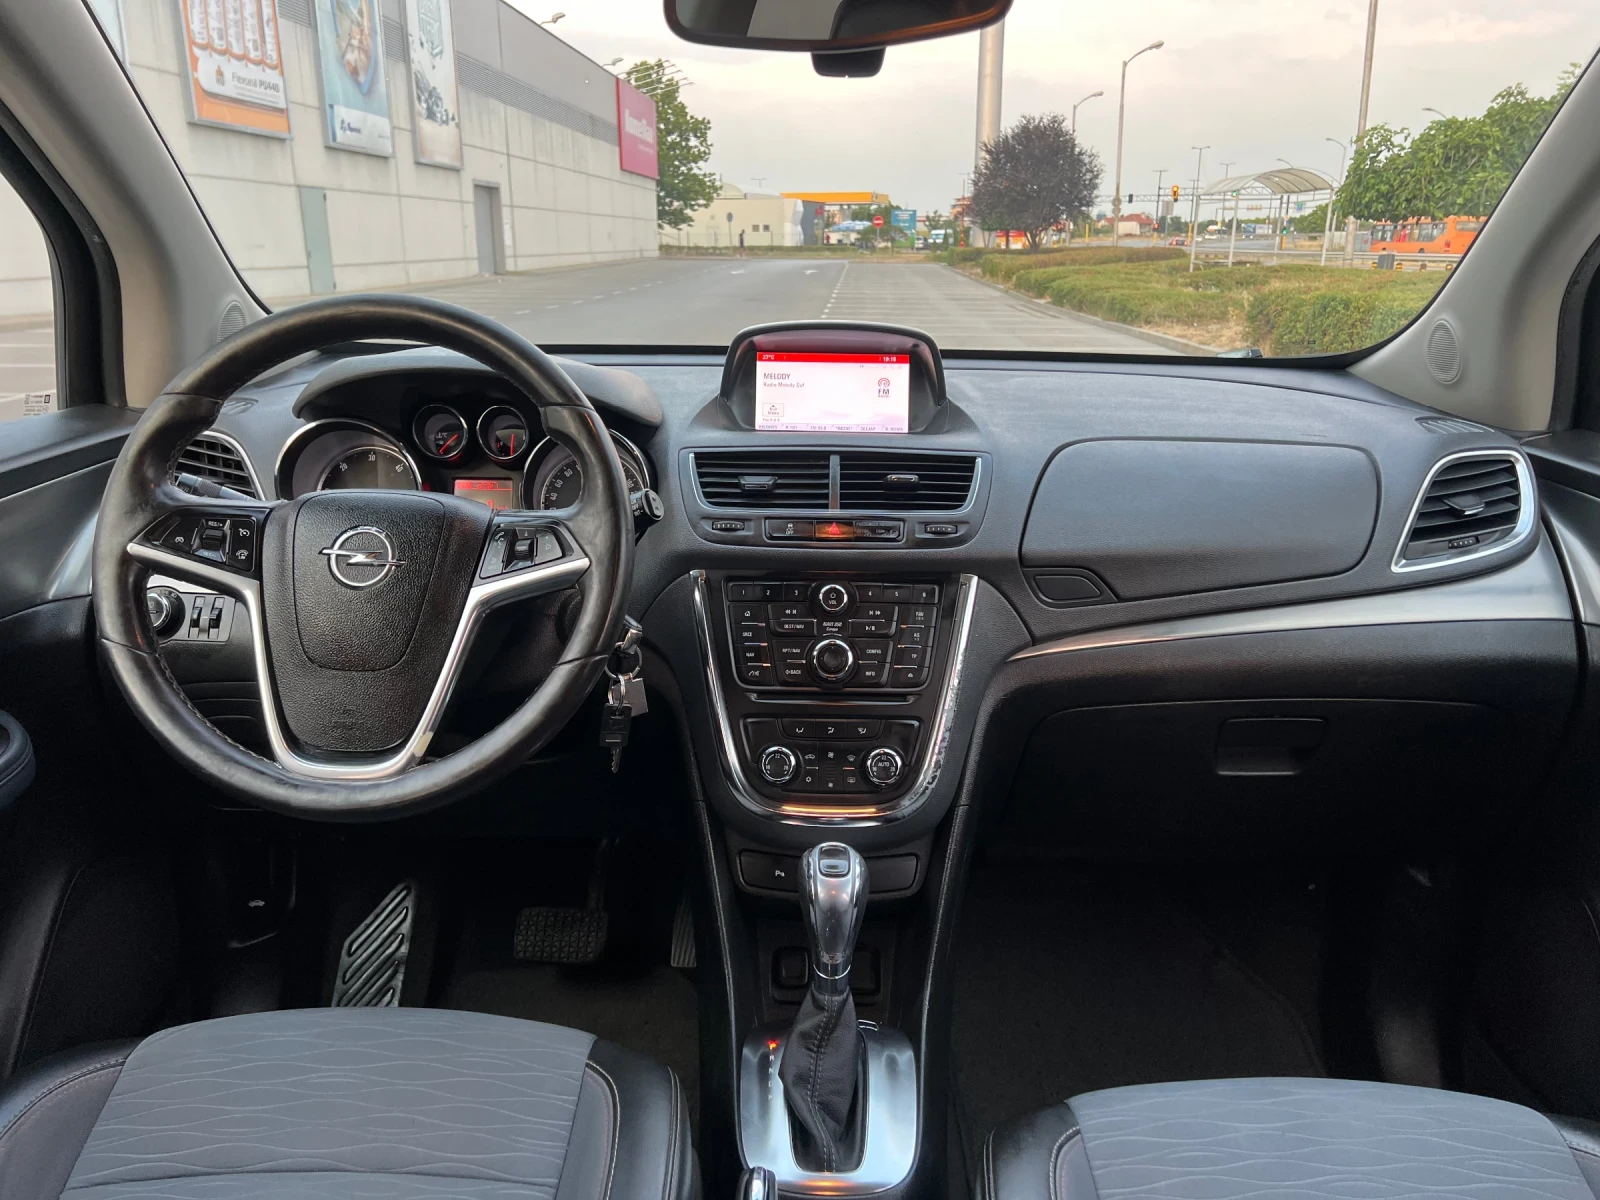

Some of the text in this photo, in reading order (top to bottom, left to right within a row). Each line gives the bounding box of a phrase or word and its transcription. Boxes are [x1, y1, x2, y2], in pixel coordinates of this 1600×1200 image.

[763, 372, 791, 381] MELODY
[368, 454, 376, 462] 30
[339, 461, 348, 472] 20
[563, 468, 573, 478] 80
[554, 479, 564, 488] 60
[549, 492, 558, 501] 40
